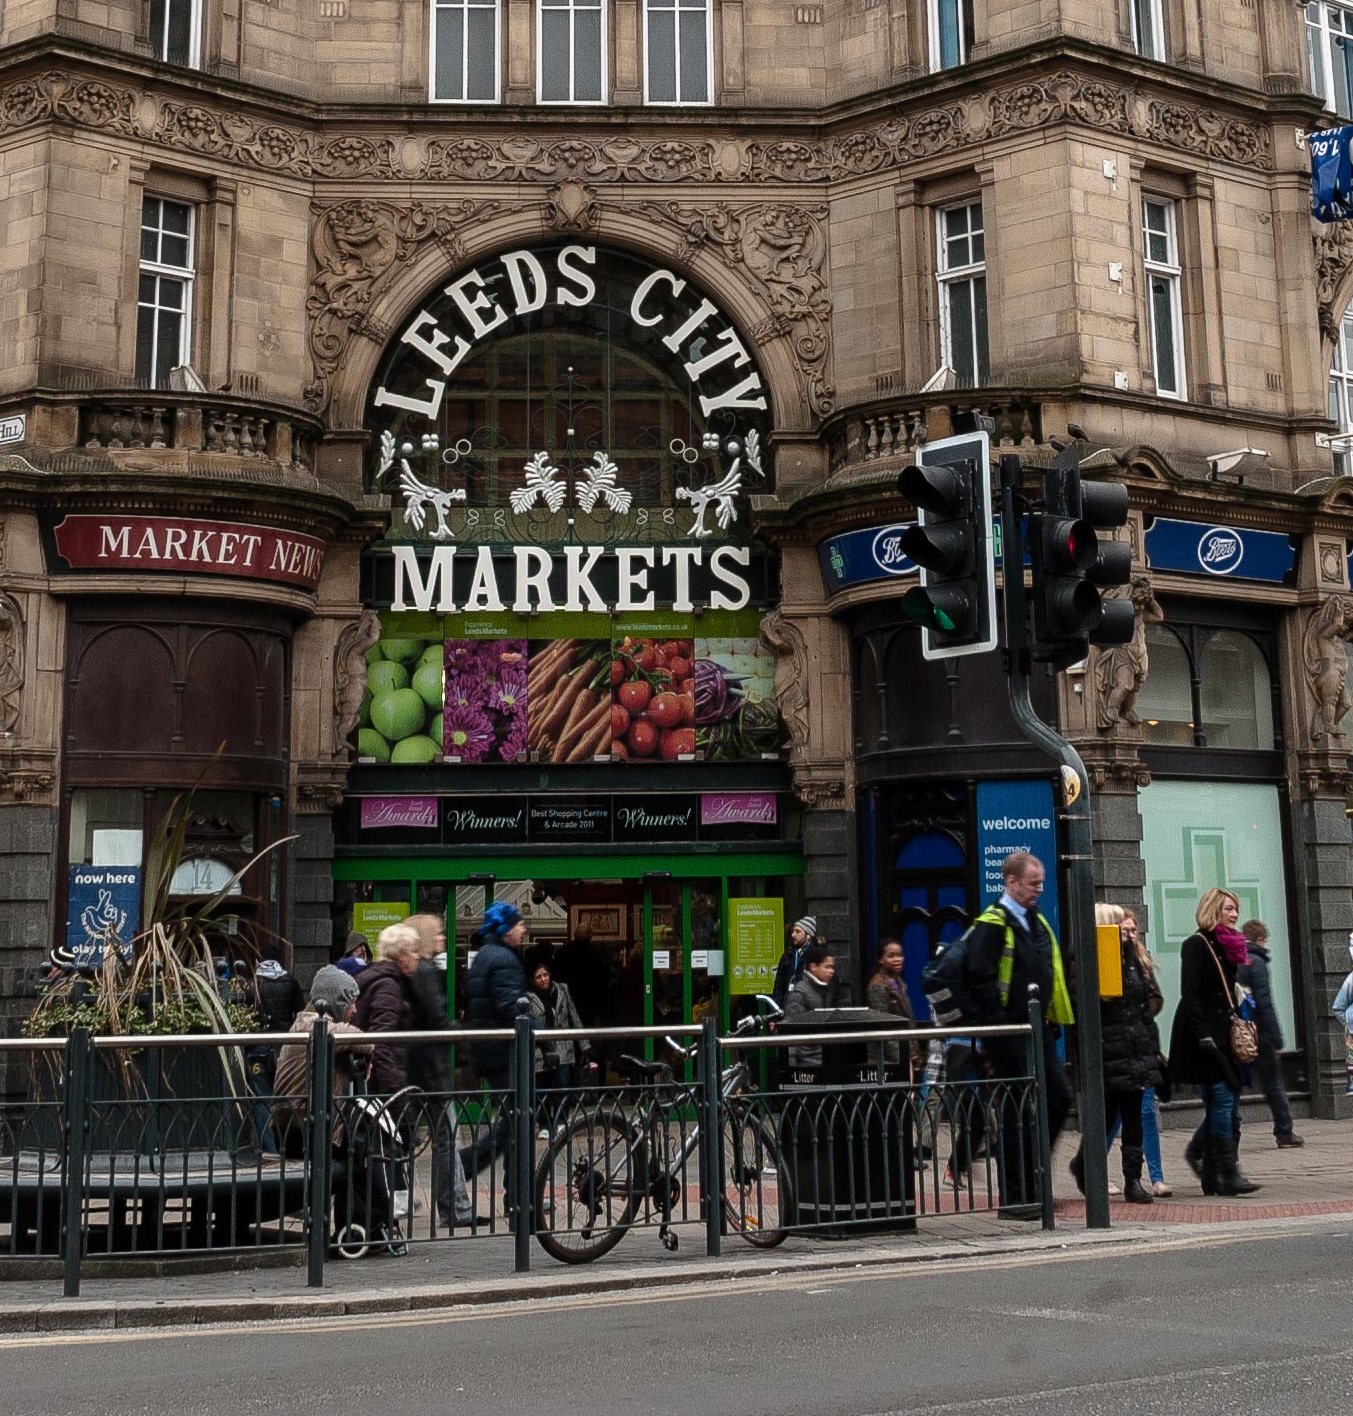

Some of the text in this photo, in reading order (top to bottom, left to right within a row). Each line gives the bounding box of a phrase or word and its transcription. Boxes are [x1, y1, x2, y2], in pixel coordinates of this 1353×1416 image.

[373, 244, 767, 420] LEEDS CITY
[98, 525, 324, 580] MARKET NEWS
[1204, 534, 1237, 566] Boots
[391, 545, 750, 612] MARKETS
[447, 810, 522, 830] Winners!
[531, 809, 608, 819] Best Shopping Centre
[618, 807, 692, 828] Winners!
[552, 820, 578, 828] Arcade
[579, 820, 595, 828] 2011
[982, 816, 1050, 830] welcome
[984, 845, 1031, 855] pharmacy
[75, 872, 136, 884] now here
[192, 863, 213, 890] 14
[794, 1071, 814, 1083] Litter
[860, 1070, 888, 1082] Littr
